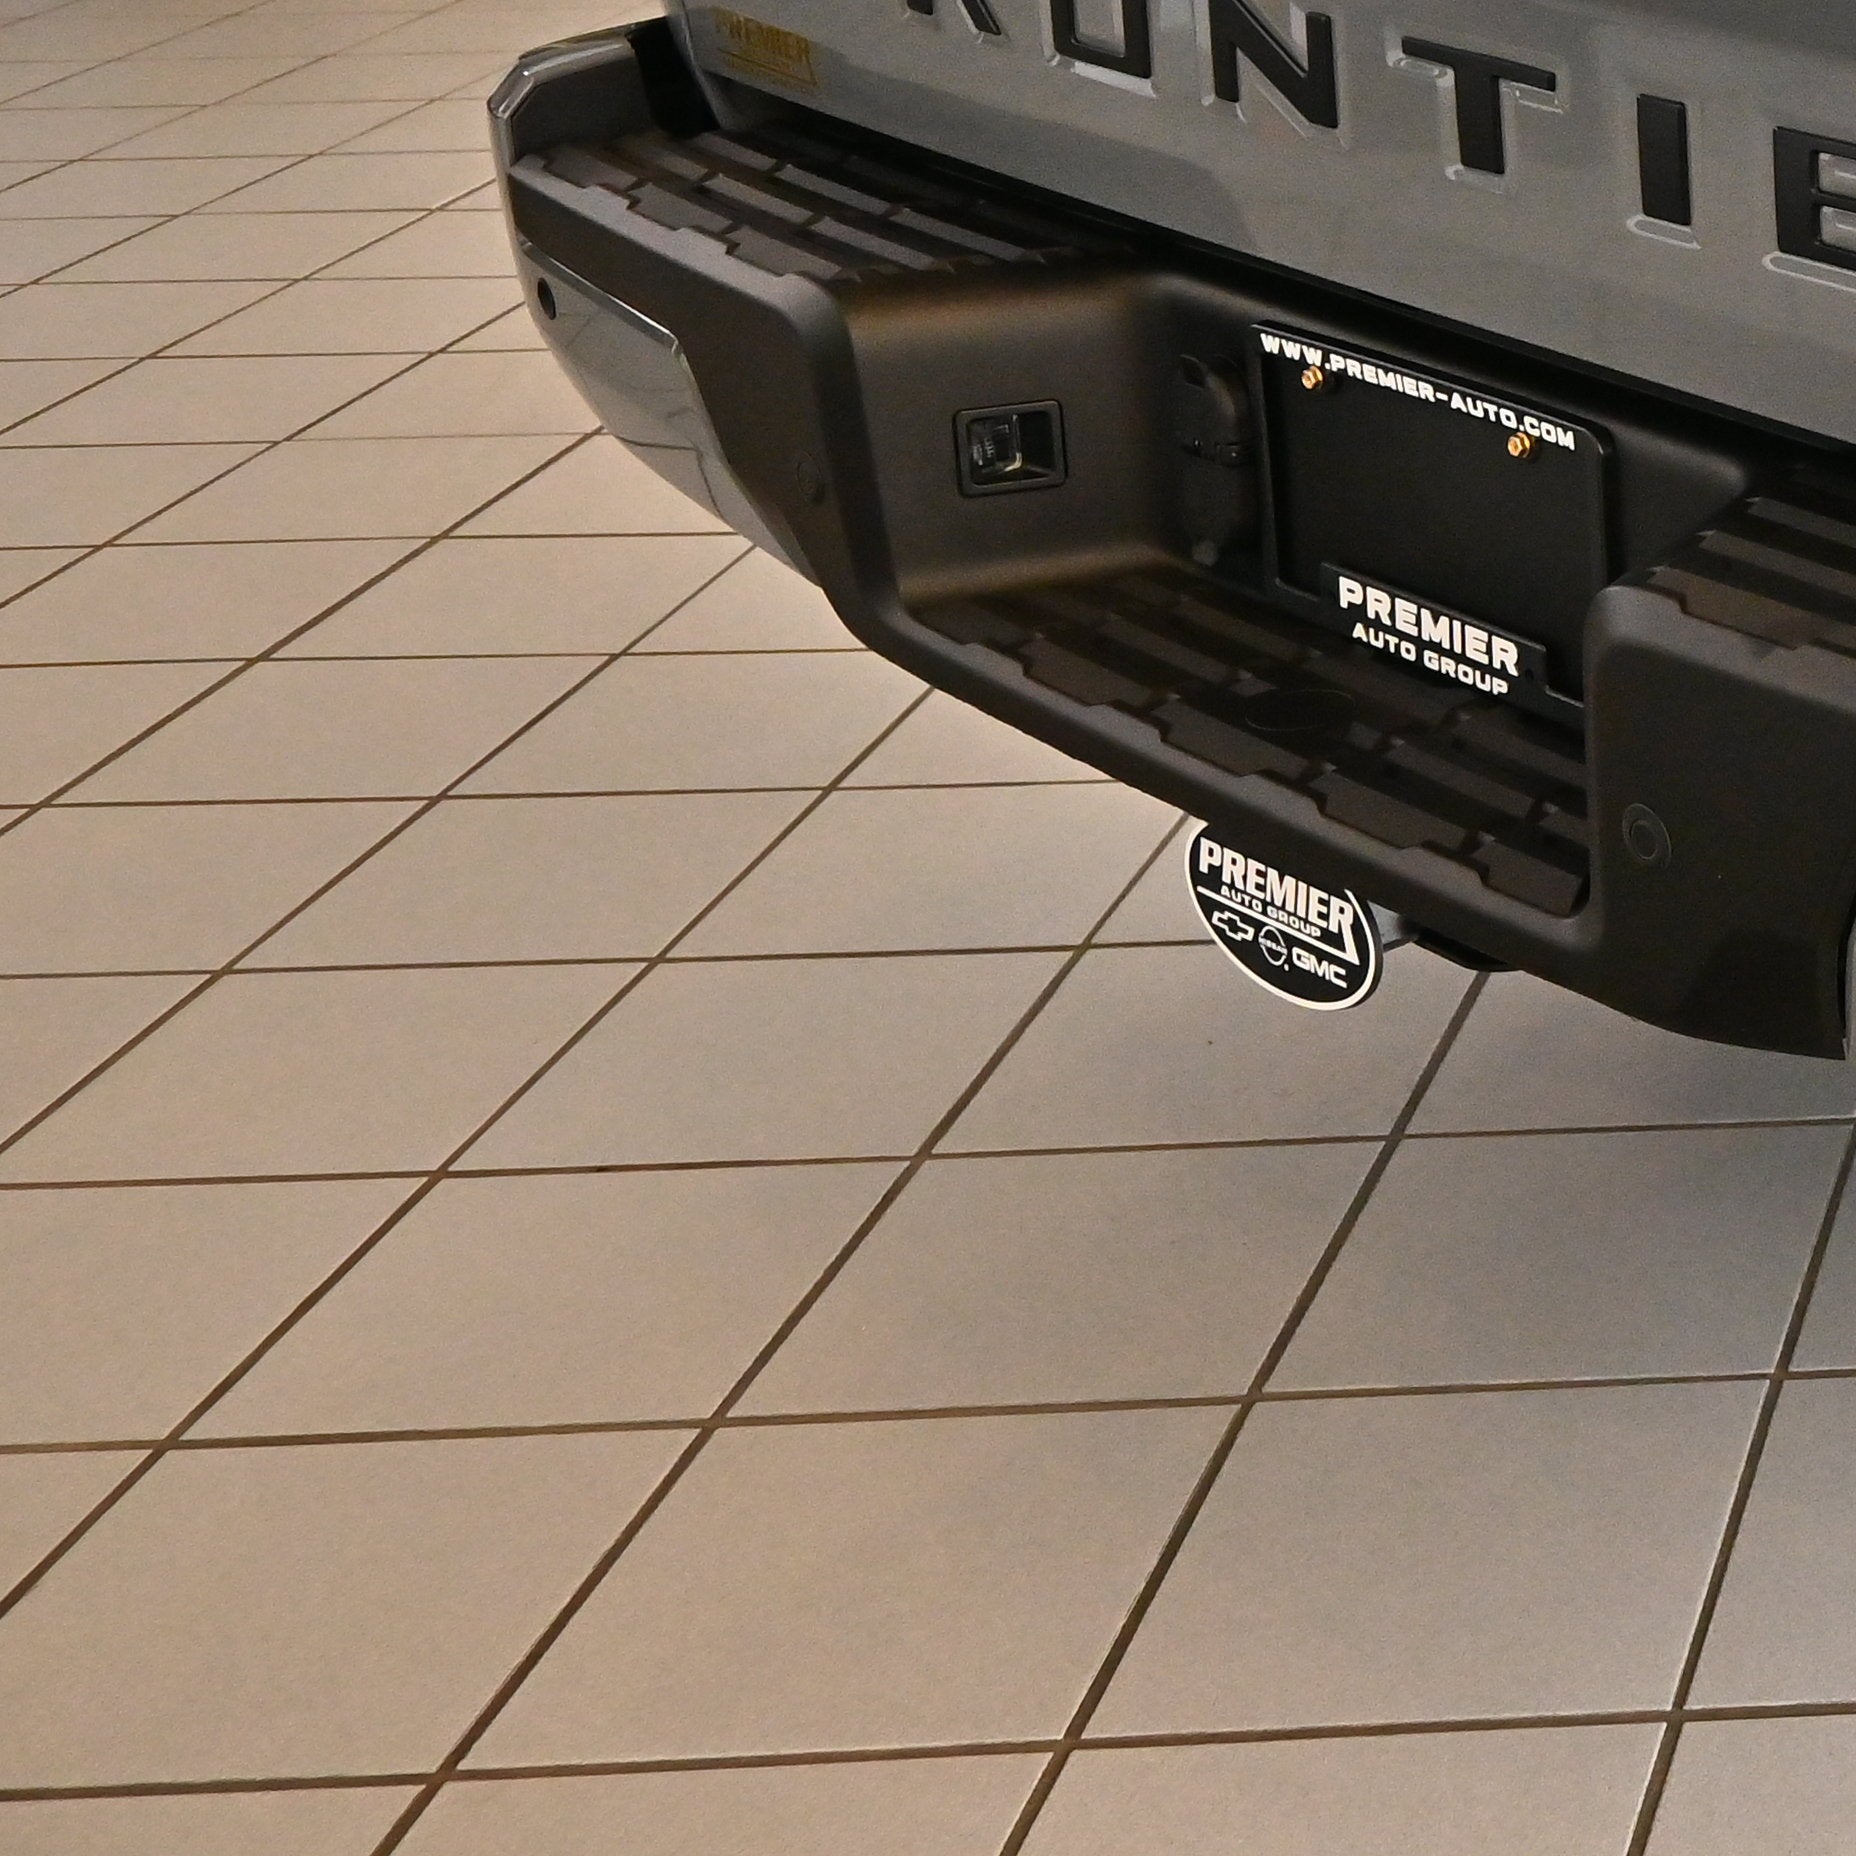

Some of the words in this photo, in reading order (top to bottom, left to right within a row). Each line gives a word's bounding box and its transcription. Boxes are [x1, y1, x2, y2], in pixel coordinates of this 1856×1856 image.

[1260, 332, 1576, 451] WWW.PREMIER-AUTO.COM
[1338, 575, 1519, 678] PREMIER
[1352, 622, 1416, 662] AUTO
[1423, 648, 1510, 696] GROUP
[1199, 836, 1356, 938] PREMIER
[1220, 885, 1263, 913] AUTO
[1266, 905, 1321, 938] GROUP
[1292, 946, 1348, 989] GMC
